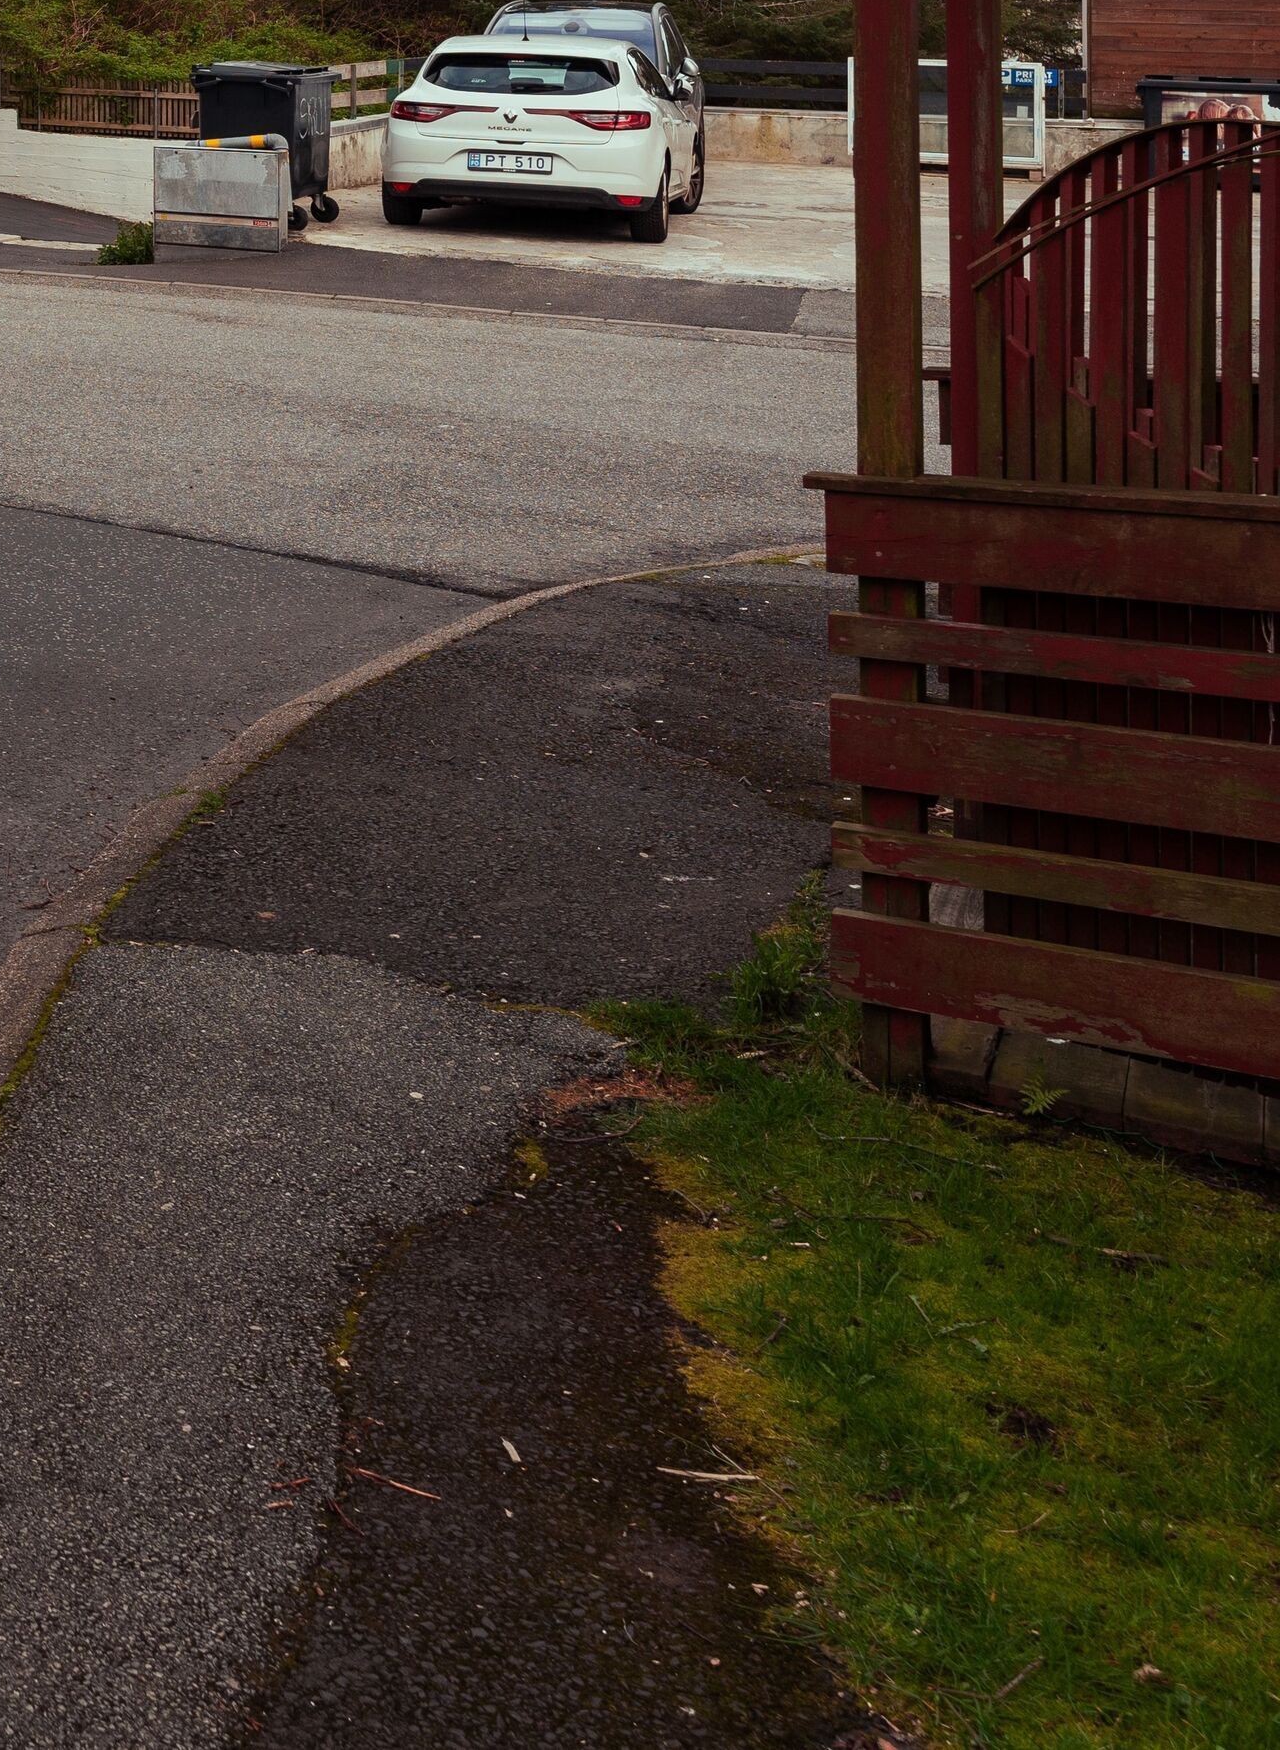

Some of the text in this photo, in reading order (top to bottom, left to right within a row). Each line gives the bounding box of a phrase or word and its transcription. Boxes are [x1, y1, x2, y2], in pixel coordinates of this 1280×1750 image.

[1015, 71, 1053, 79] PRIAT
[485, 155, 545, 169] PT 510
